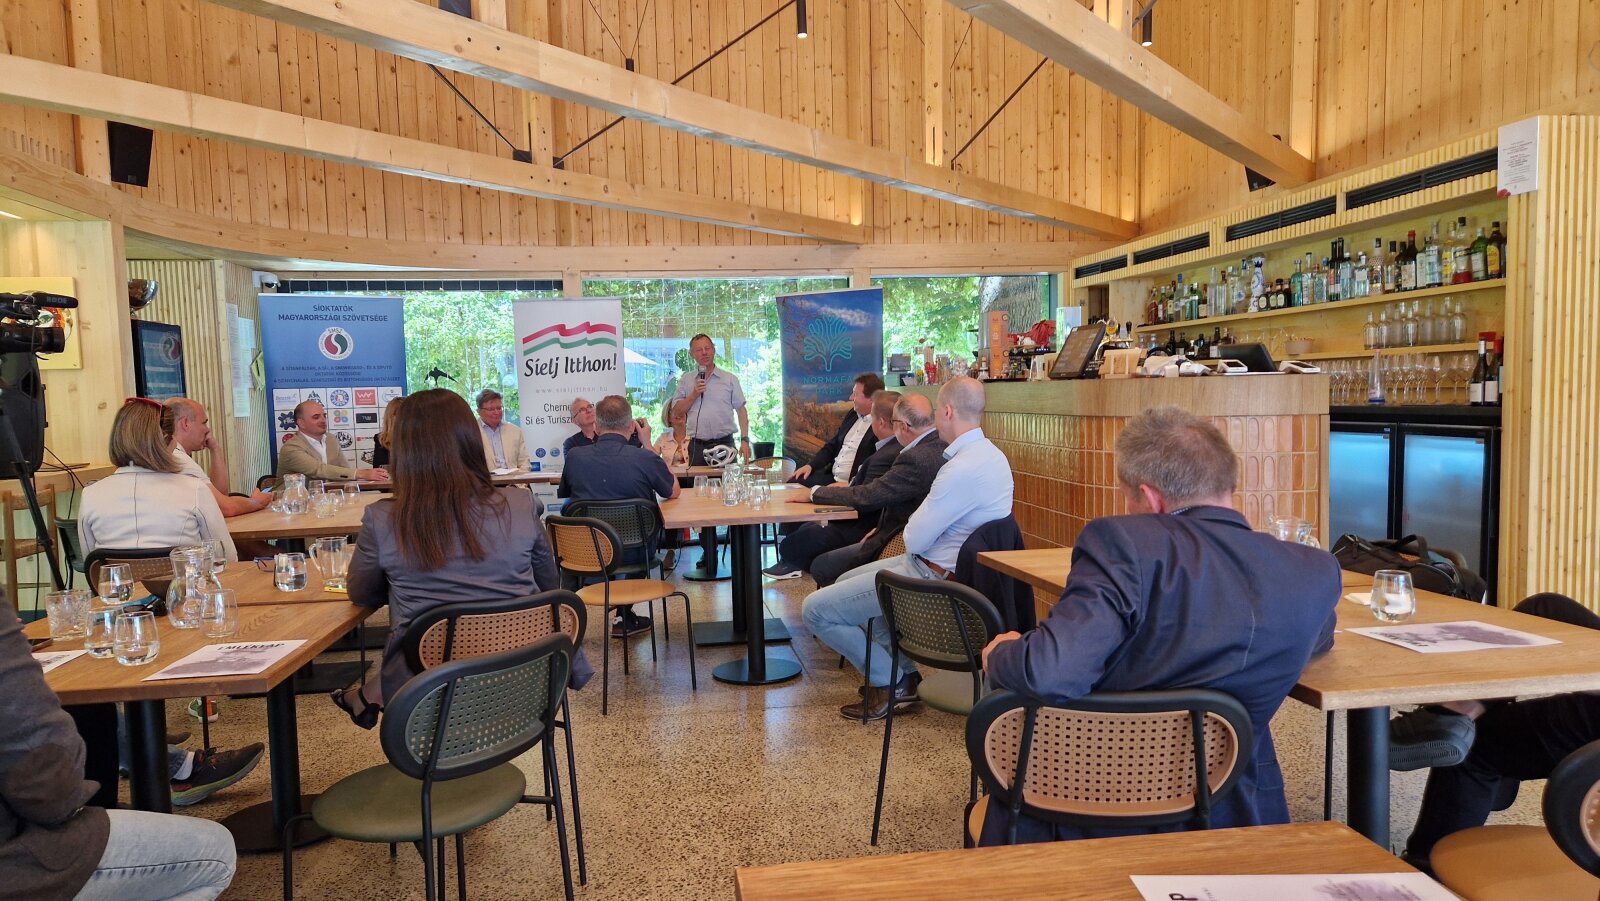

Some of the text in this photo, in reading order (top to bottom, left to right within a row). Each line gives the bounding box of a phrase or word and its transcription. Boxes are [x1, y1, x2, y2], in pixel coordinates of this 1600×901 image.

[313, 303, 353, 312] SÍOKTATÓK
[278, 313, 388, 322] MAGYARORSZÁGI SZÖVETSÉGE
[524, 353, 617, 379] Síelj Itthon!
[803, 376, 852, 385] NORMAFA
[816, 386, 842, 395] PARK
[535, 416, 545, 425] és
